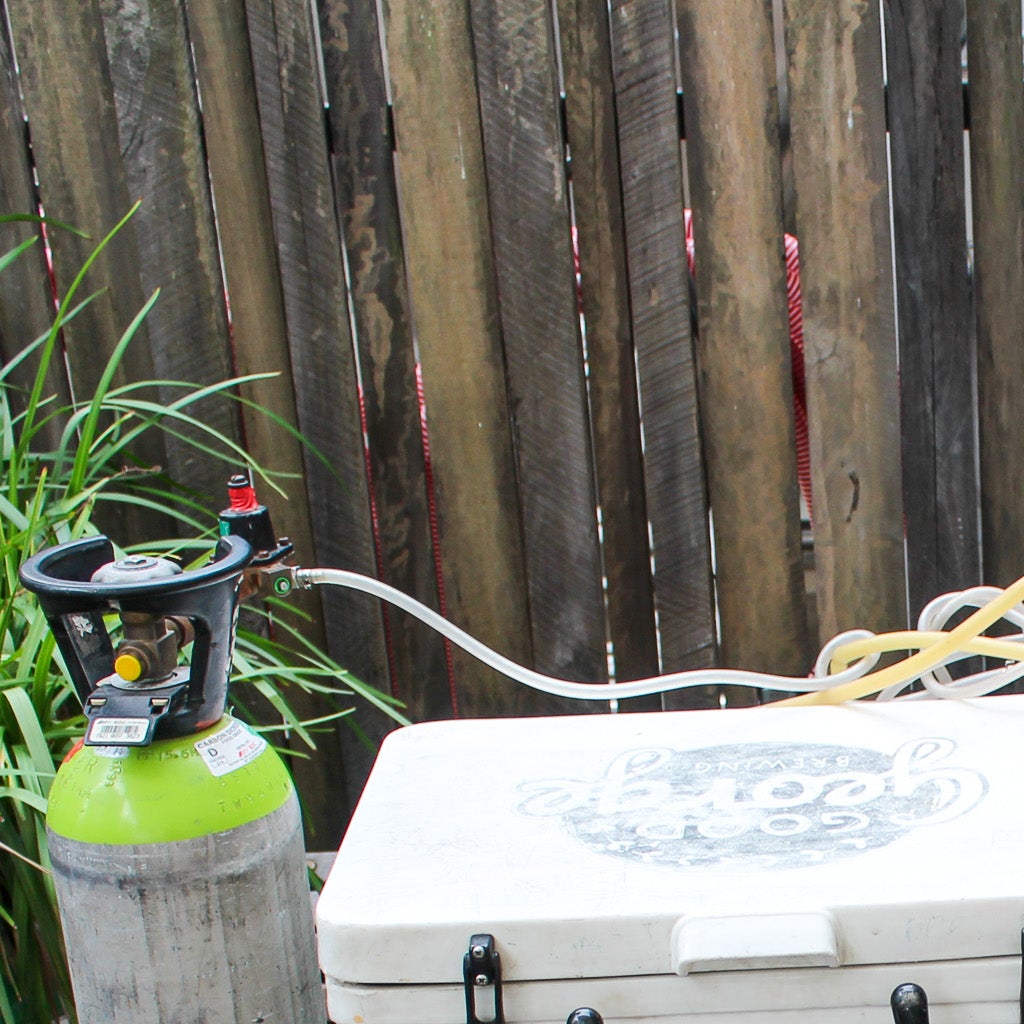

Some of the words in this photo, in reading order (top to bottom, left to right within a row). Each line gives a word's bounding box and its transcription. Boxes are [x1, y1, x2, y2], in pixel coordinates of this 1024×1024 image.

[207, 748, 218, 757] D
[693, 755, 851, 773] BREWING
[635, 811, 870, 840] GOOD
